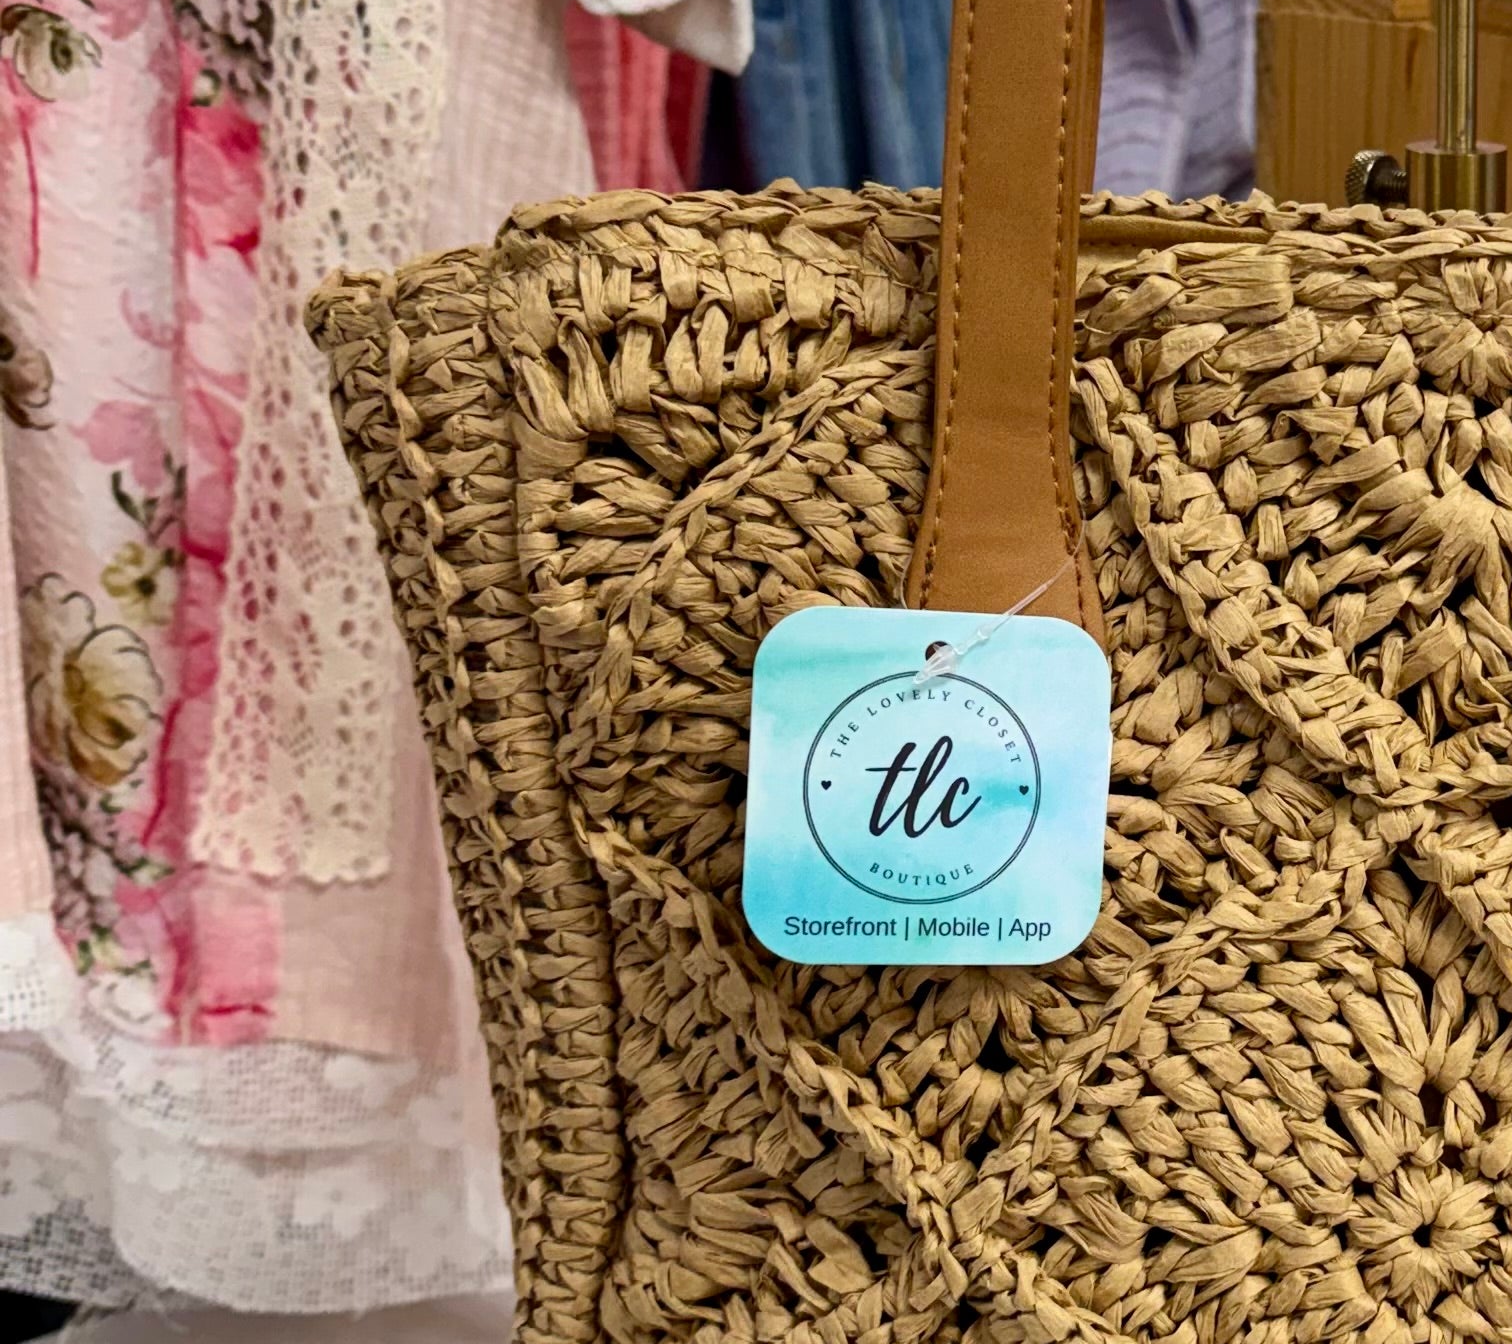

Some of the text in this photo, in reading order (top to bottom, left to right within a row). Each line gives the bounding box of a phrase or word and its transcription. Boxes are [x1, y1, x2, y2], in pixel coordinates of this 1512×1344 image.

[829, 688, 1022, 764] THE LOVELY CLOSET
[865, 735, 983, 839] tlc
[869, 862, 975, 887] BOUTIQUE
[784, 915, 897, 937] Storefront
[917, 917, 990, 937] Mobile
[1008, 918, 1052, 941] App
